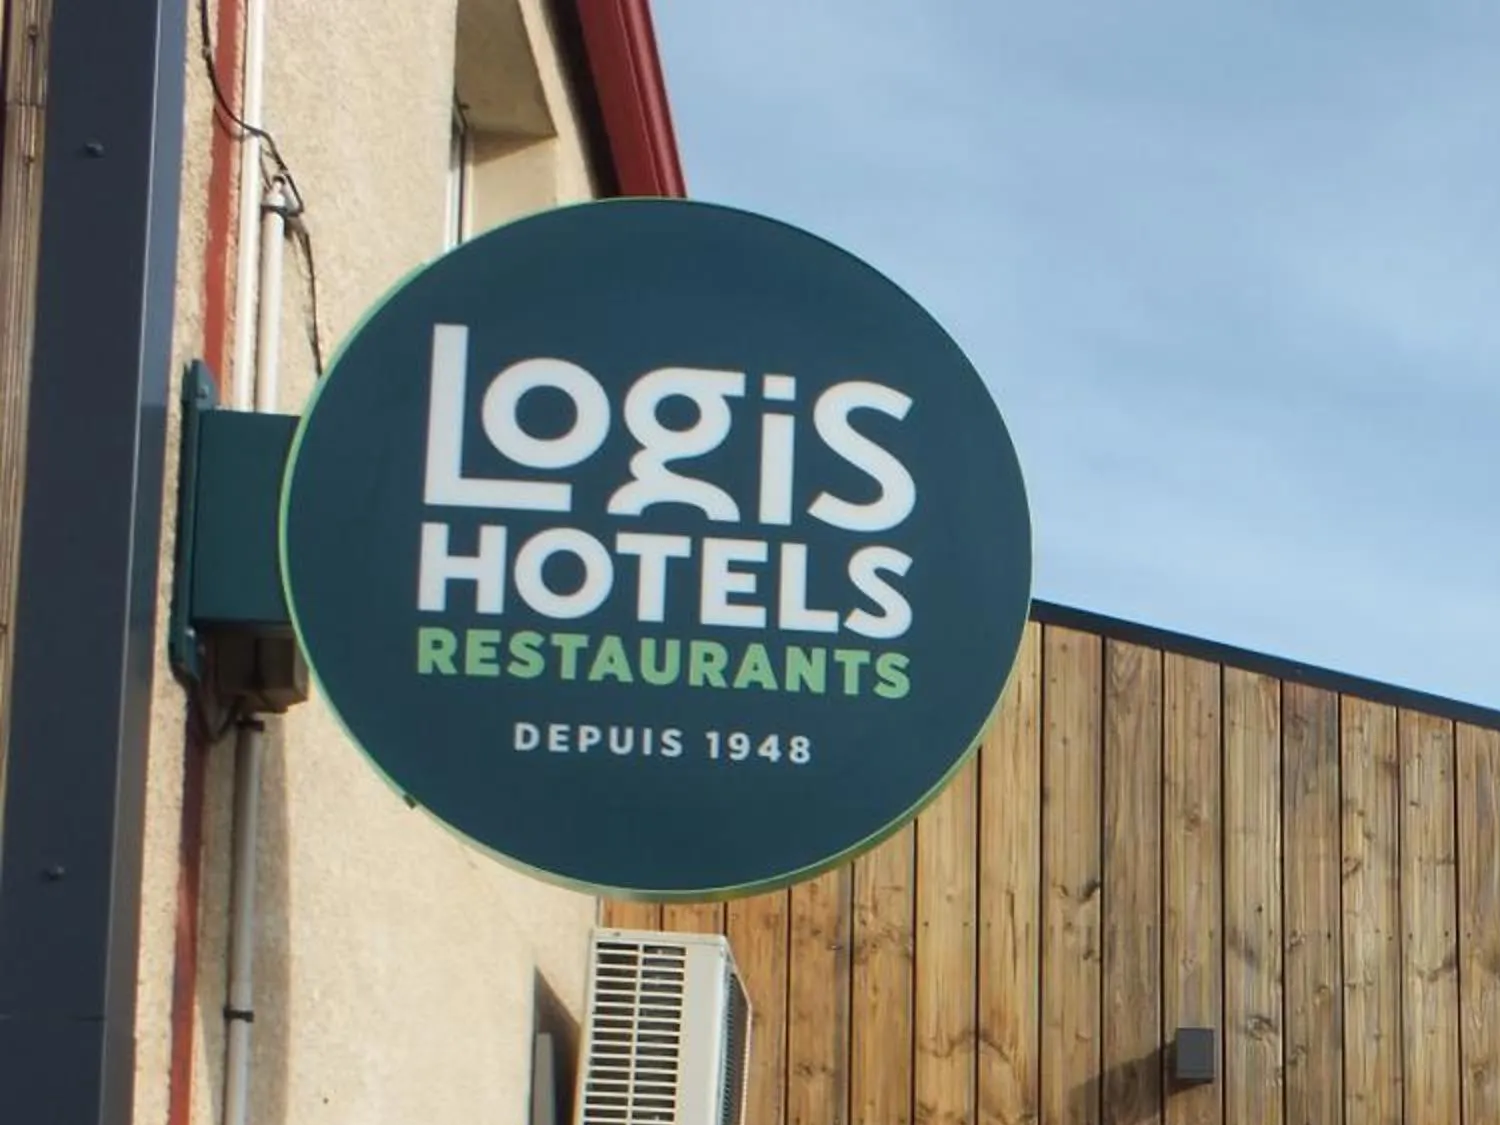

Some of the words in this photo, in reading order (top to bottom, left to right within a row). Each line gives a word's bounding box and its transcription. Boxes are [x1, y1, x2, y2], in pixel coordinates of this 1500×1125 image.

[417, 522, 913, 639] HOTELS
[417, 627, 911, 699] RESTAURANTS
[513, 722, 683, 757] DEPUIS
[705, 731, 812, 764] 1948
